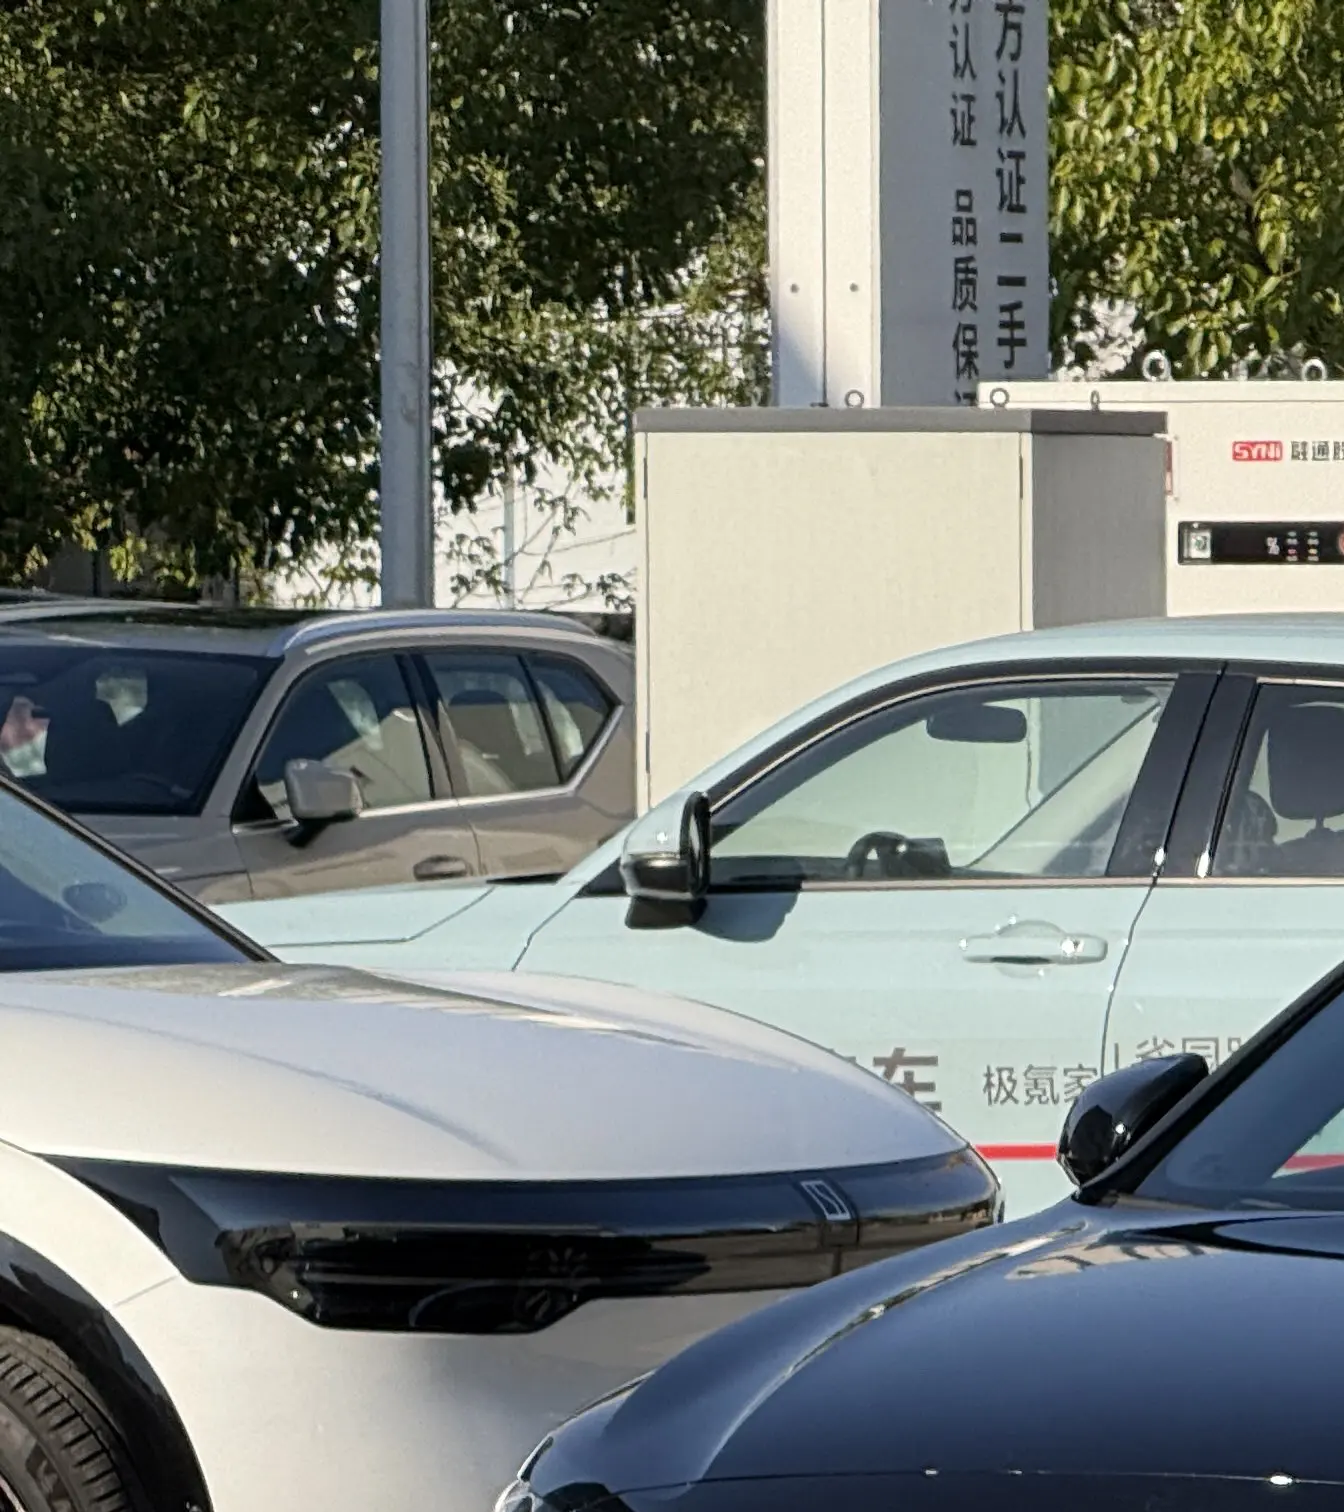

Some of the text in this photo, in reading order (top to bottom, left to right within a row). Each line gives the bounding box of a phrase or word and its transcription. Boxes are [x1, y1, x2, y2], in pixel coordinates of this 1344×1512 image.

[949, 0, 978, 406] 认证 品质保
